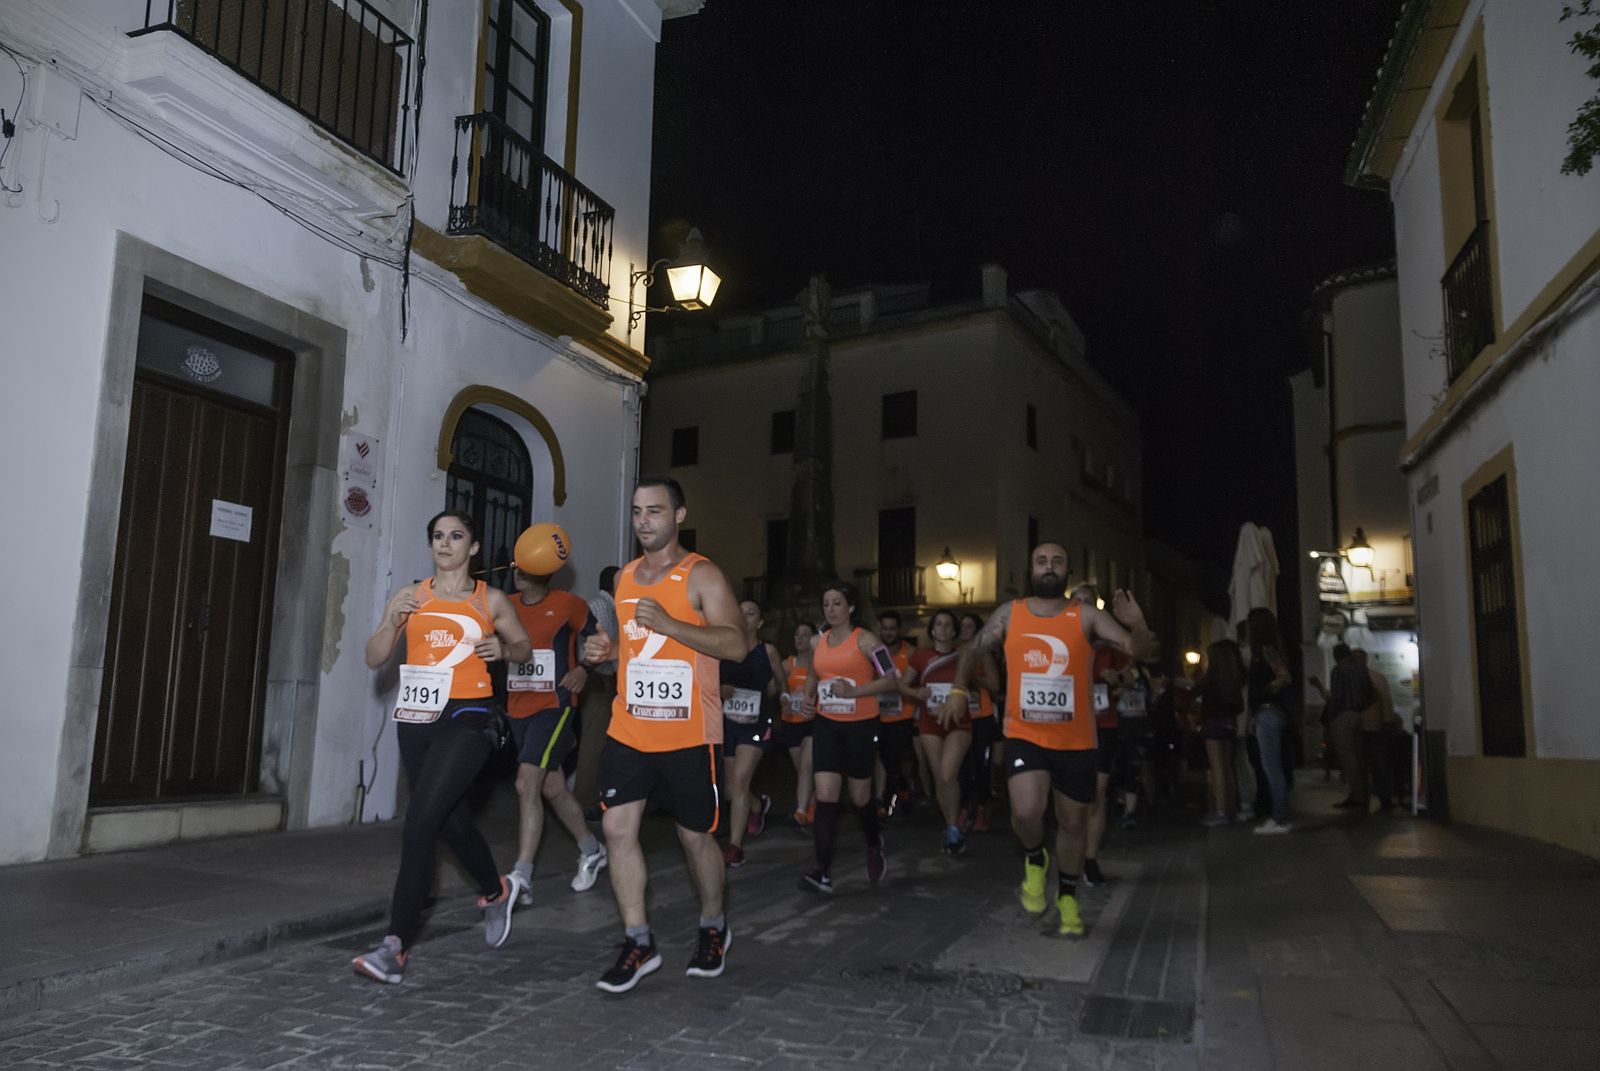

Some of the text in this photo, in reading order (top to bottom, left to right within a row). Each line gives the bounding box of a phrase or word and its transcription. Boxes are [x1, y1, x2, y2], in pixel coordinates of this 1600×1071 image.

[518, 663, 544, 676] 890
[402, 685, 439, 704] 3191
[634, 680, 683, 700] 3193
[1026, 690, 1067, 707] 3320
[728, 700, 755, 713] 3091
